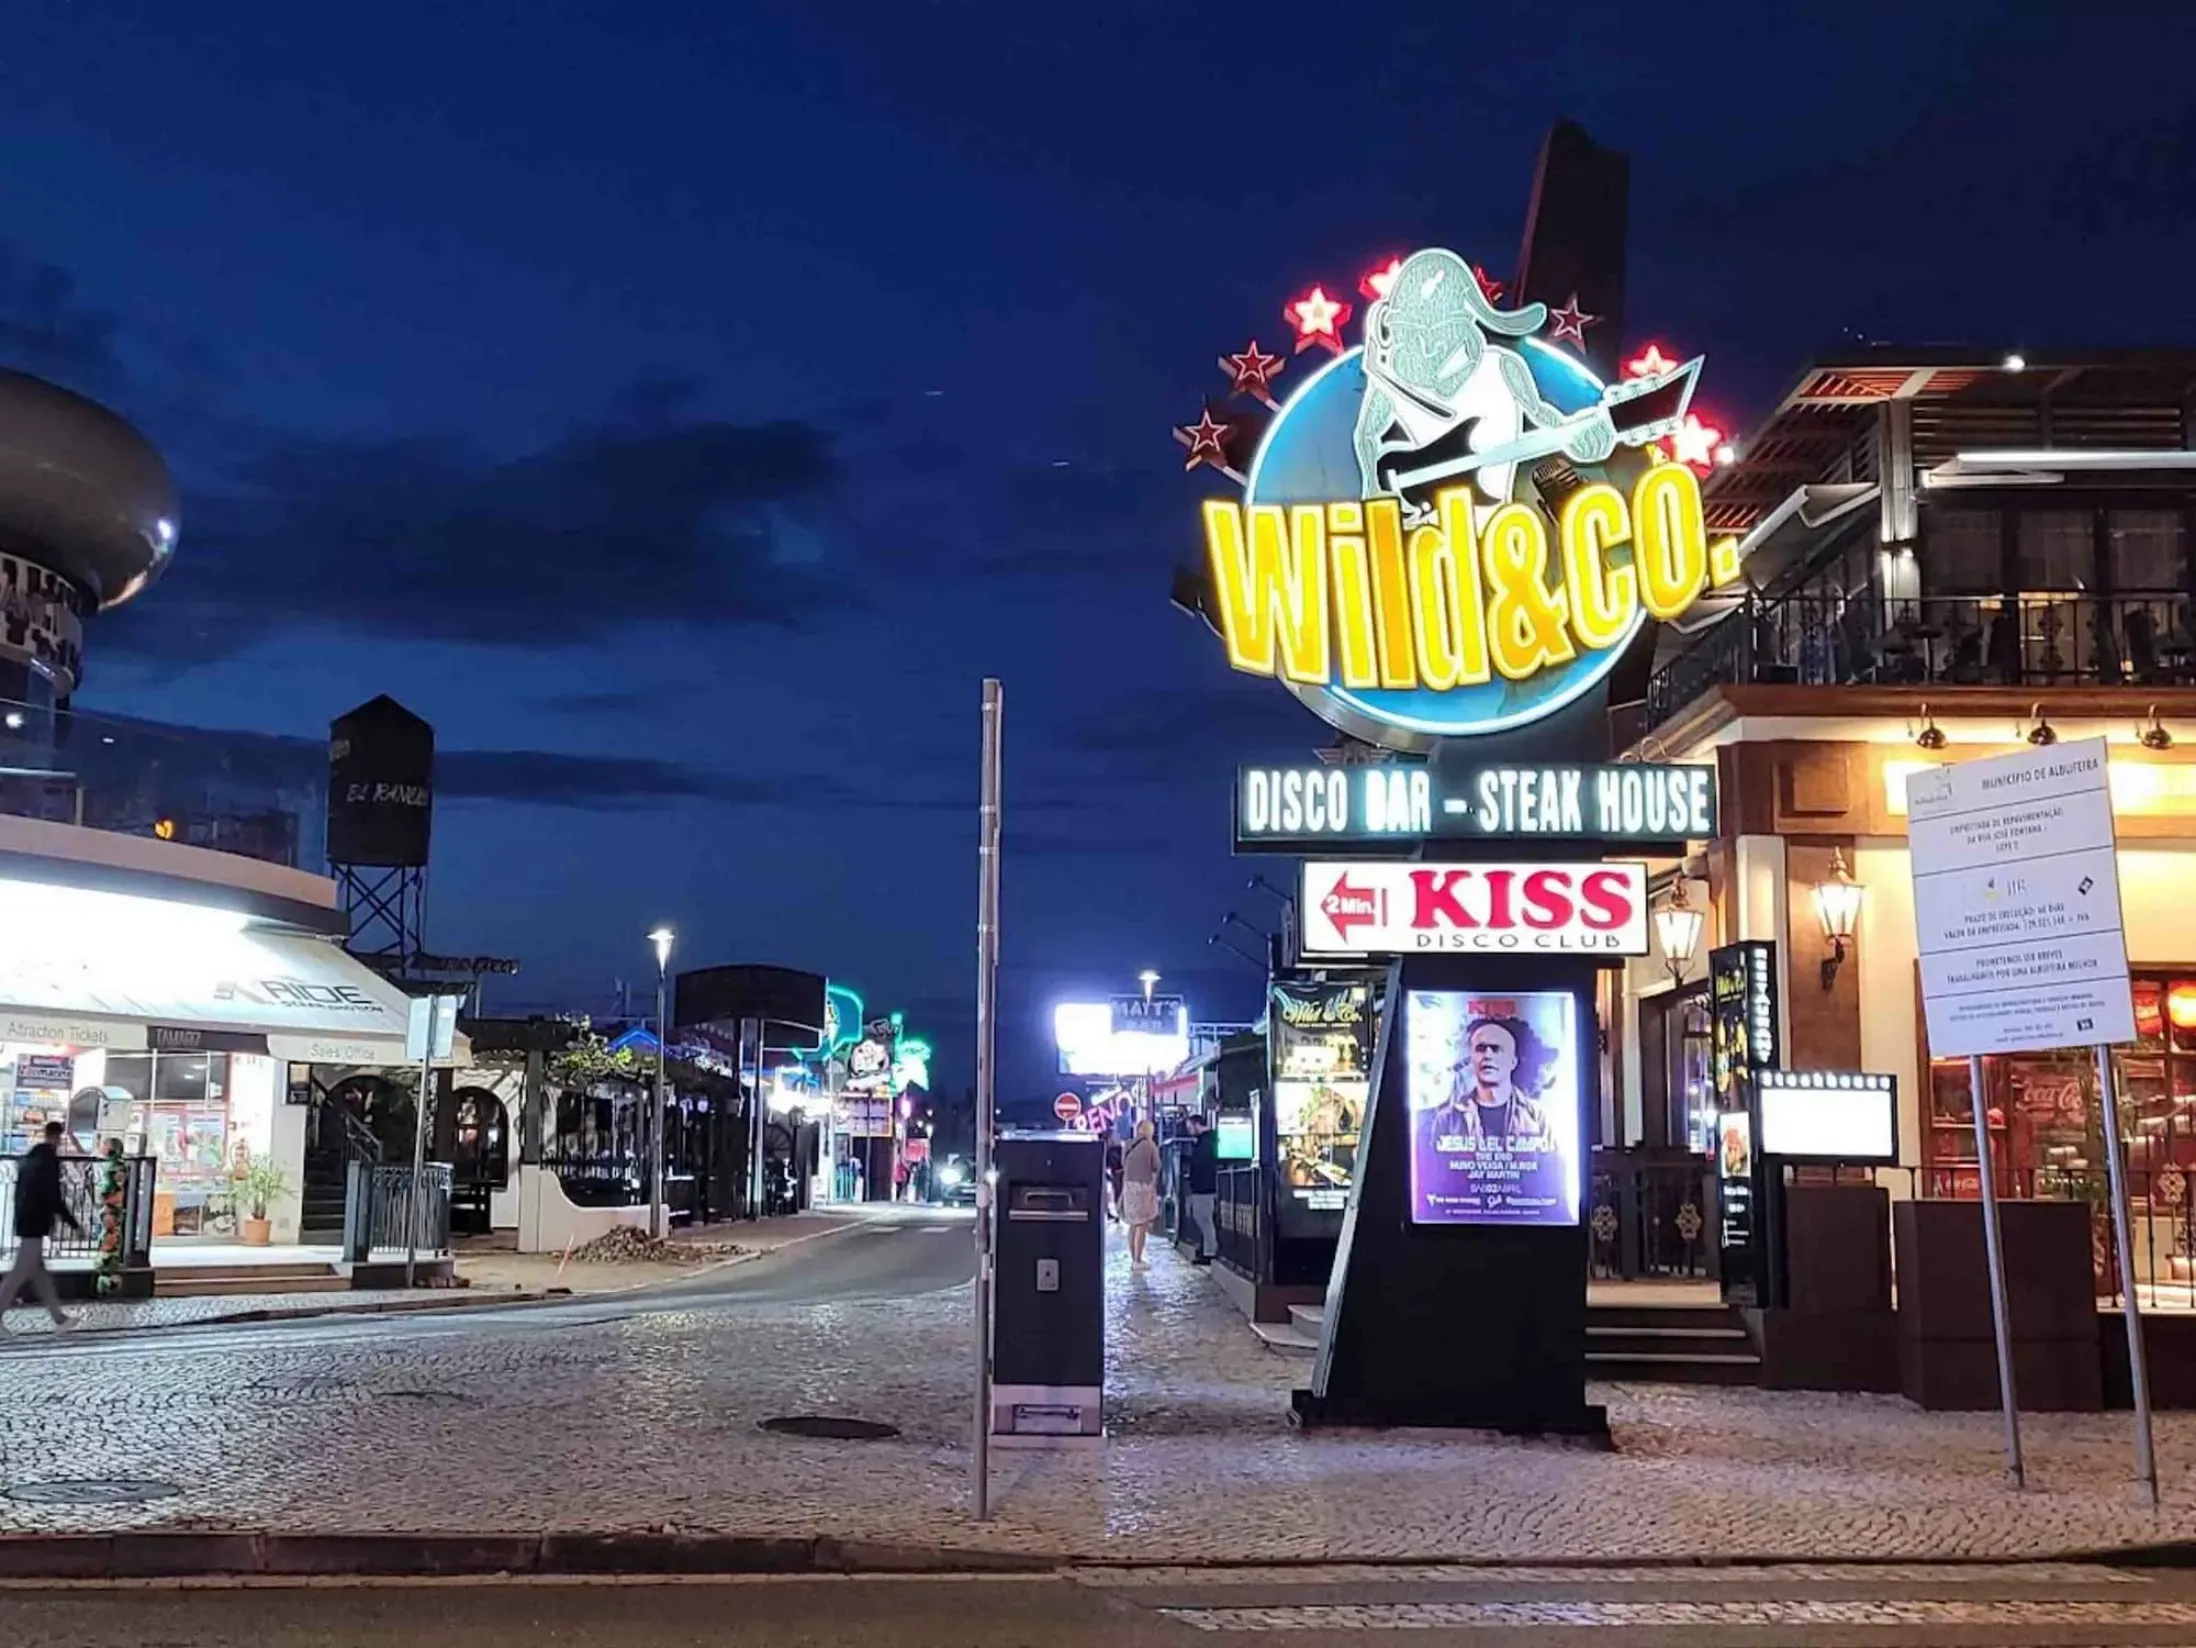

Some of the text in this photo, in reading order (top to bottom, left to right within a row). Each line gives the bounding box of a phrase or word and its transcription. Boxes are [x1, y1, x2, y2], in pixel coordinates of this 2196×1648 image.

[2034, 766, 2045, 780] DE
[2048, 758, 2098, 777] ALBUFEIRA
[1247, 769, 1348, 832] DISCO
[1365, 770, 1431, 831] BAR
[1479, 770, 1582, 832] STEAK
[1598, 770, 1711, 832] HOUSE
[1409, 870, 1632, 929] KISS
[1416, 934, 1621, 948] DISCO CLUB
